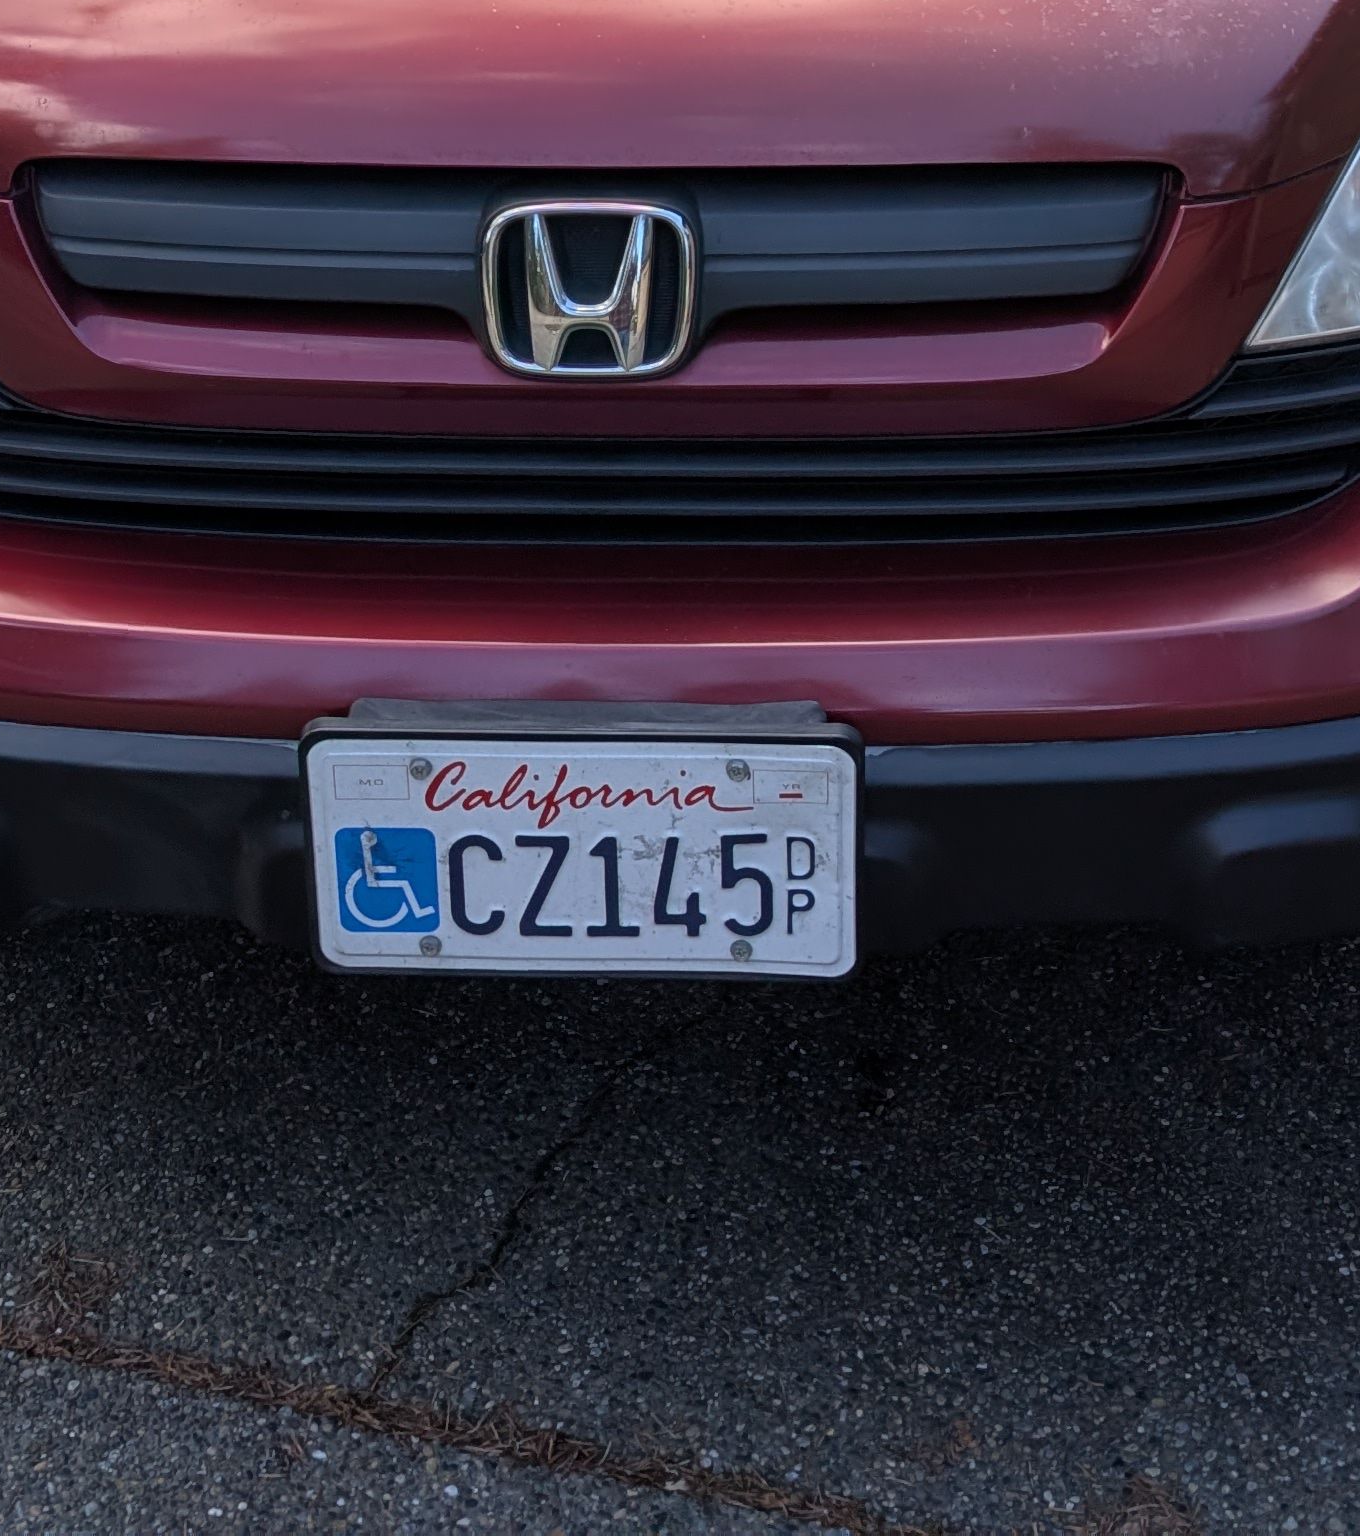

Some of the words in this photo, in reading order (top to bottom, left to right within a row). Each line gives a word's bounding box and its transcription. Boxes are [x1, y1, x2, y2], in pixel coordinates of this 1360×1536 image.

[359, 778, 384, 787] MO
[424, 761, 754, 829] California
[447, 832, 774, 938] CZ145
